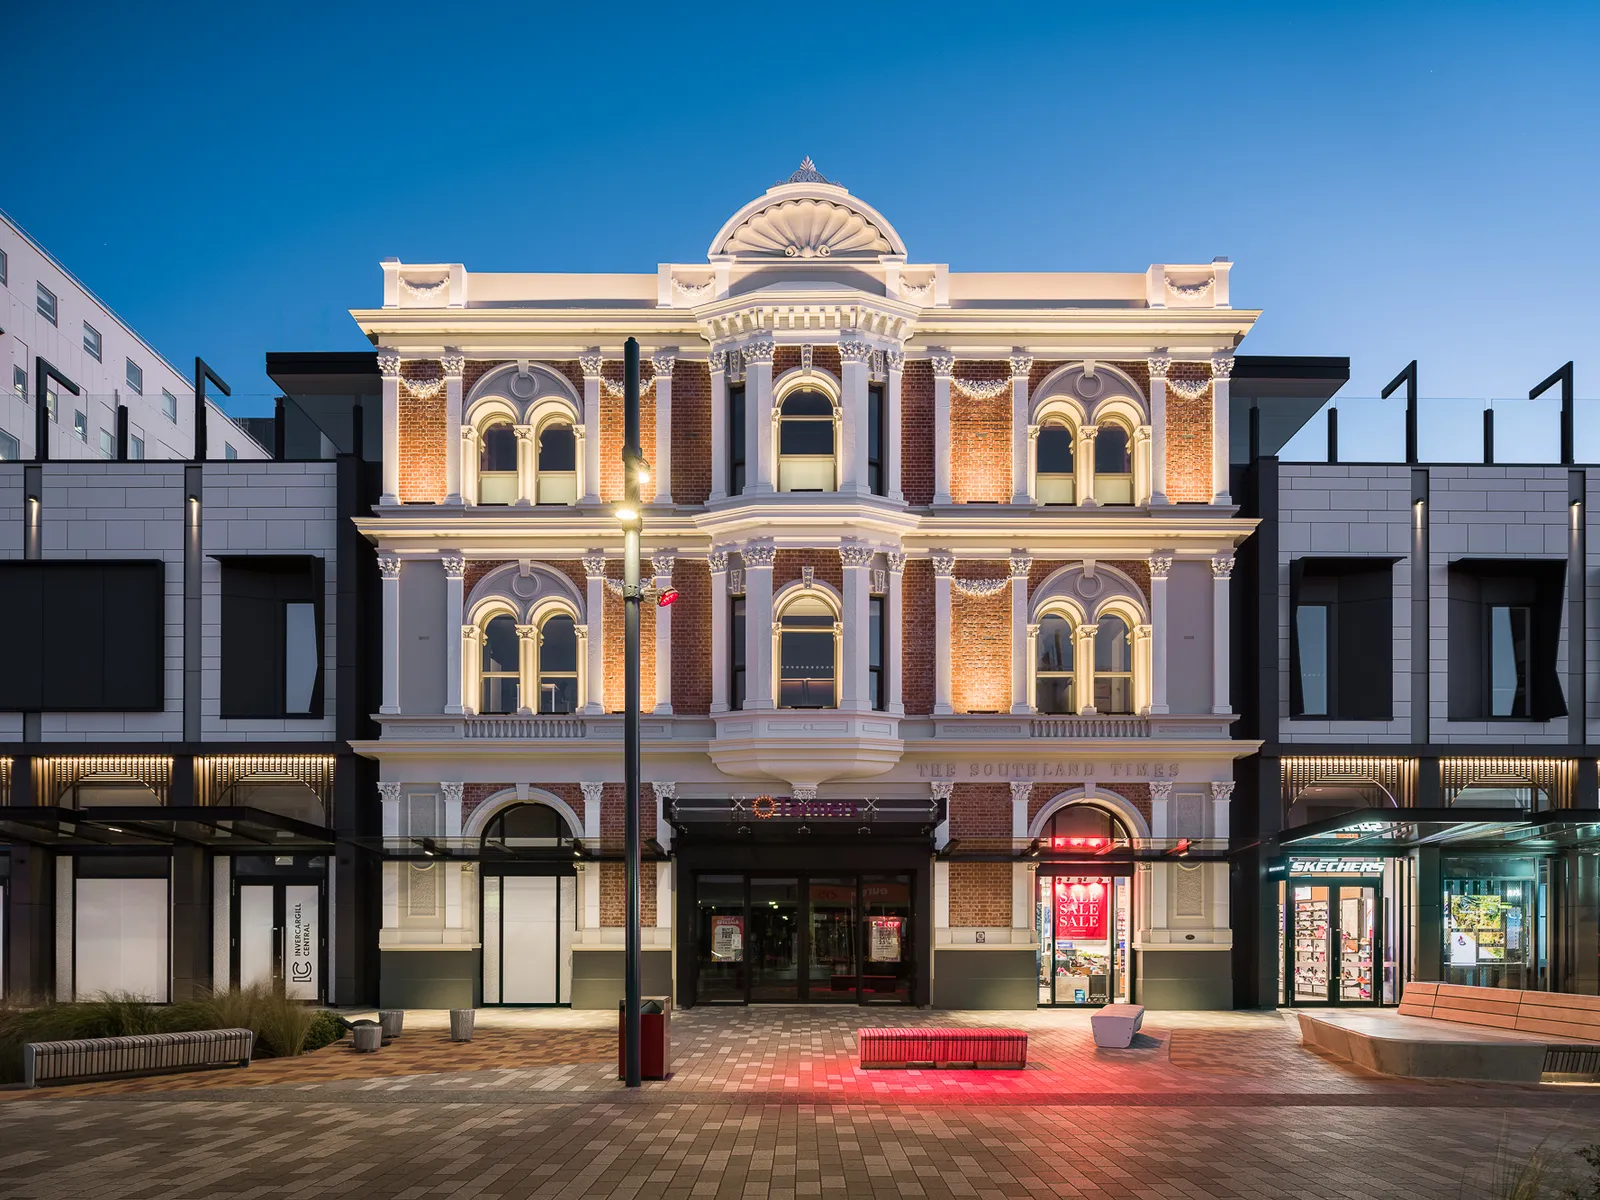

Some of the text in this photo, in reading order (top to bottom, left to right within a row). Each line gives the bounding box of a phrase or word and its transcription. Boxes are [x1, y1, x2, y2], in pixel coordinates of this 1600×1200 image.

[916, 763, 1180, 778] THE SOUTHLAND TIMES
[777, 796, 858, 817] Farmers
[1290, 861, 1386, 873] SKECHERS
[1059, 891, 1099, 903] SALE
[1059, 903, 1099, 915] SALE
[1059, 915, 1099, 927] SALE
[294, 902, 302, 957] INVERCARGILL
